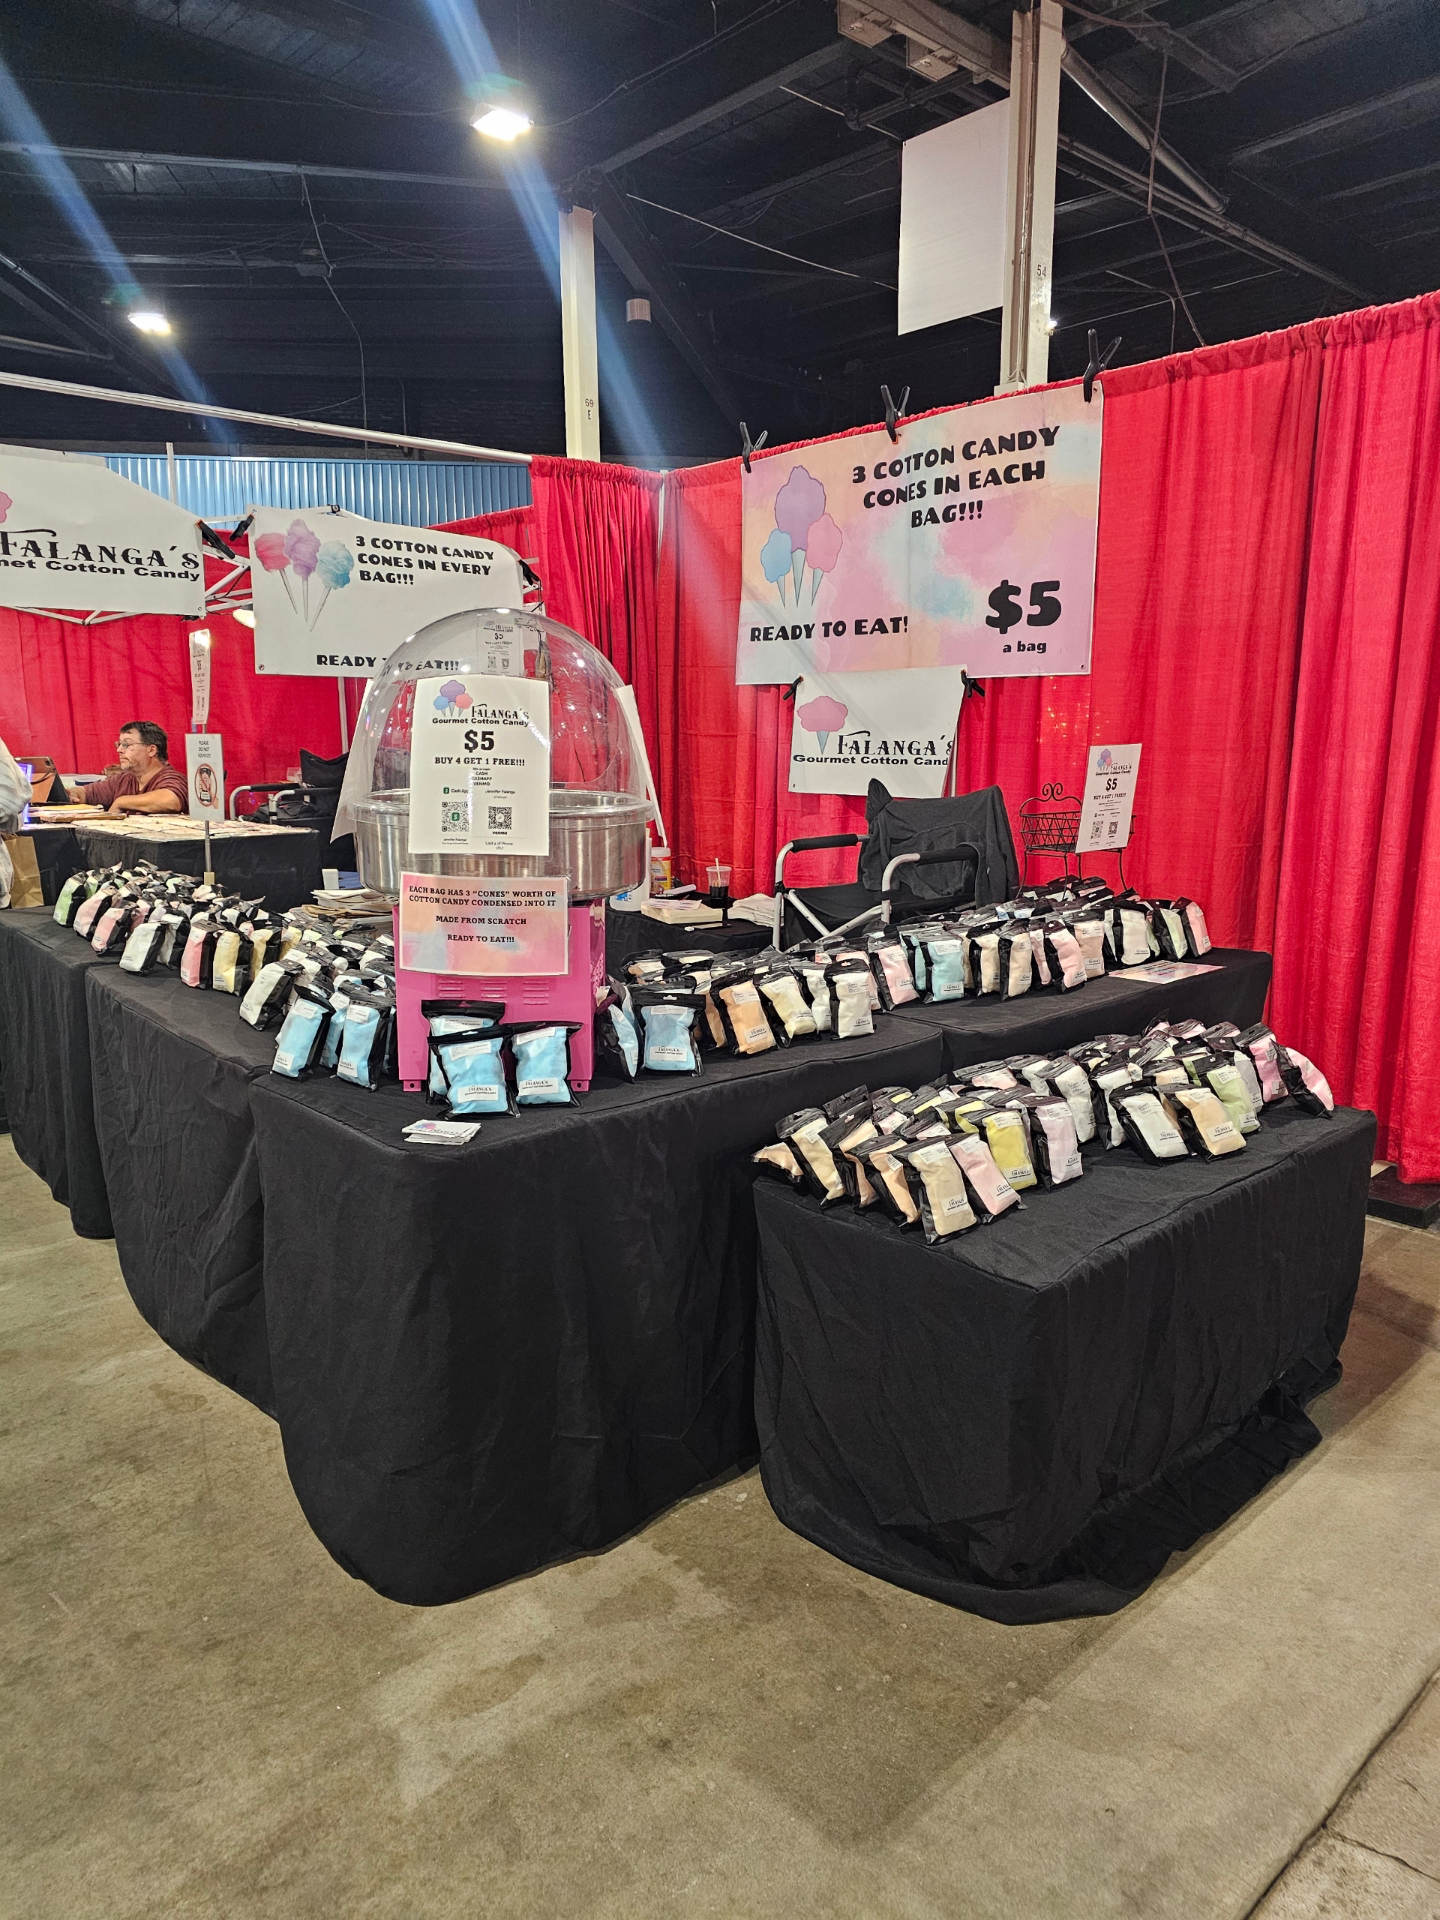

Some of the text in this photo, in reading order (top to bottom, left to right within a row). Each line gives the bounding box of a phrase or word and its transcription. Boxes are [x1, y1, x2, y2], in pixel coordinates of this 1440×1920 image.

[853, 426, 1060, 484] 3 COTTON CANDY
[863, 460, 1046, 509] CONES IN EACH
[911, 500, 984, 529] BAG!!!
[0, 529, 200, 569] FALANGA'S
[356, 536, 494, 560] 3 COTTON CANDY
[46, 561, 126, 575] Cotton
[134, 567, 200, 582] Candy
[357, 553, 491, 576] CONES IN EVERY
[359, 570, 414, 585] BAG!!!
[985, 580, 1062, 635] $5
[750, 616, 909, 642] READY TO EAT!
[1002, 640, 1047, 655] a bag
[316, 654, 377, 668] READY
[472, 703, 530, 719] FALANGA'S
[502, 718, 529, 728] Candy
[464, 729, 495, 753] $5
[435, 757, 453, 765] BUY
[463, 757, 483, 765] GET
[492, 758, 525, 766] FREE!!!
[793, 754, 948, 765] Gourmet Cotton Cand
[1105, 777, 1118, 792] $5
[409, 885, 429, 894] EACH
[430, 887, 446, 896] BAG
[448, 888, 464, 896] HAS
[512, 890, 543, 898] WORTH
[409, 894, 440, 904] COTTON
[442, 897, 469, 906] CANDY
[471, 899, 523, 907] CONDENSED
[547, 899, 556, 907] IT
[436, 915, 459, 923] MADE
[447, 934, 474, 942] READY
[476, 935, 488, 943] TO
